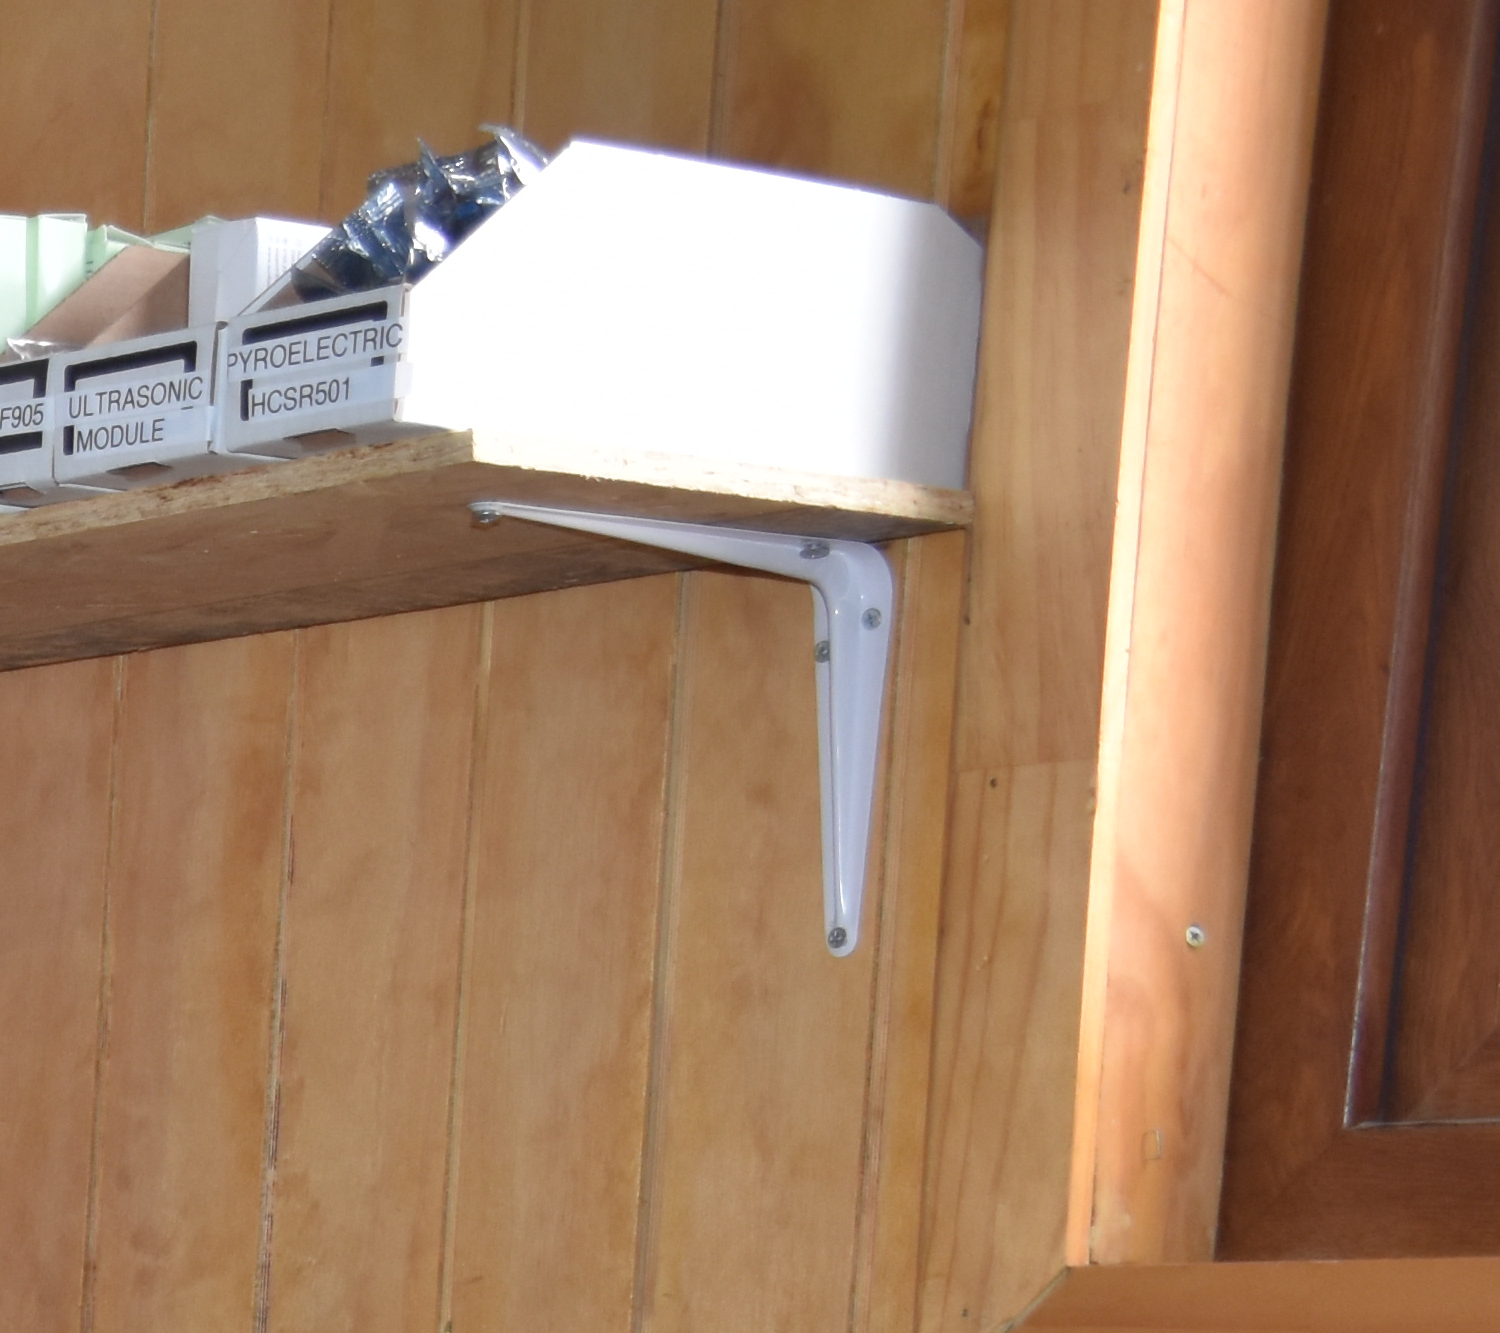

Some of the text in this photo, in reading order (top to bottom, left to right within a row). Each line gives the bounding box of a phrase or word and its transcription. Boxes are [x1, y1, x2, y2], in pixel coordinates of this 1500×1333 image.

[227, 323, 403, 382] PYROELECTRIC
[68, 376, 203, 419] ULTRASONIC
[250, 377, 351, 418] HCSR501
[76, 418, 165, 453] MODULE
